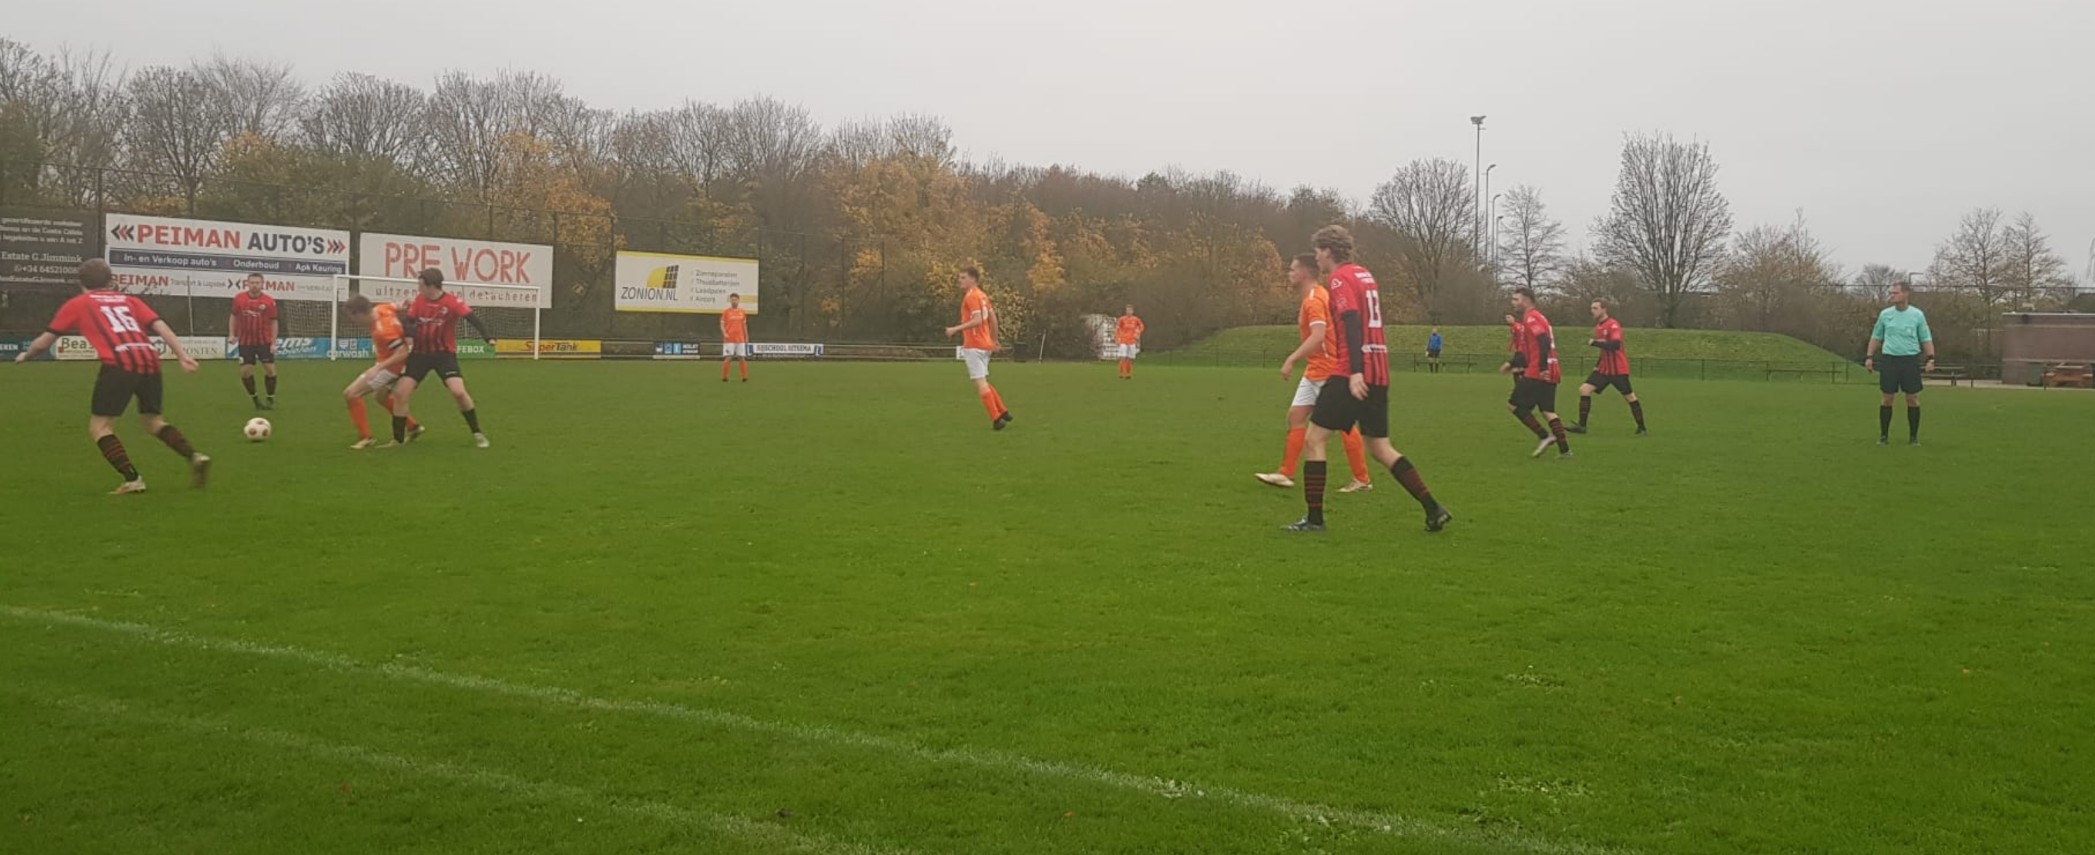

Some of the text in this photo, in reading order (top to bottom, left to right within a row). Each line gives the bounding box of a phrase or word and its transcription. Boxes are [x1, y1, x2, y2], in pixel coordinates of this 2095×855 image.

[137, 224, 325, 254] PEIMAN AUTO'S
[1, 251, 30, 261] Estate
[124, 253, 136, 261] In-
[152, 255, 189, 266] Verkoop
[190, 257, 217, 266] auto's
[233, 259, 279, 269] Onderhoud
[295, 263, 342, 273] Apk Keuring
[385, 242, 531, 284] PRE WORK
[111, 274, 169, 286] PEIMAN
[242, 280, 295, 291] PMAN
[376, 286, 418, 297] uitzen
[621, 287, 678, 301] ZONION.NL
[100, 306, 141, 333] 16
[525, 341, 578, 352] SperTank
